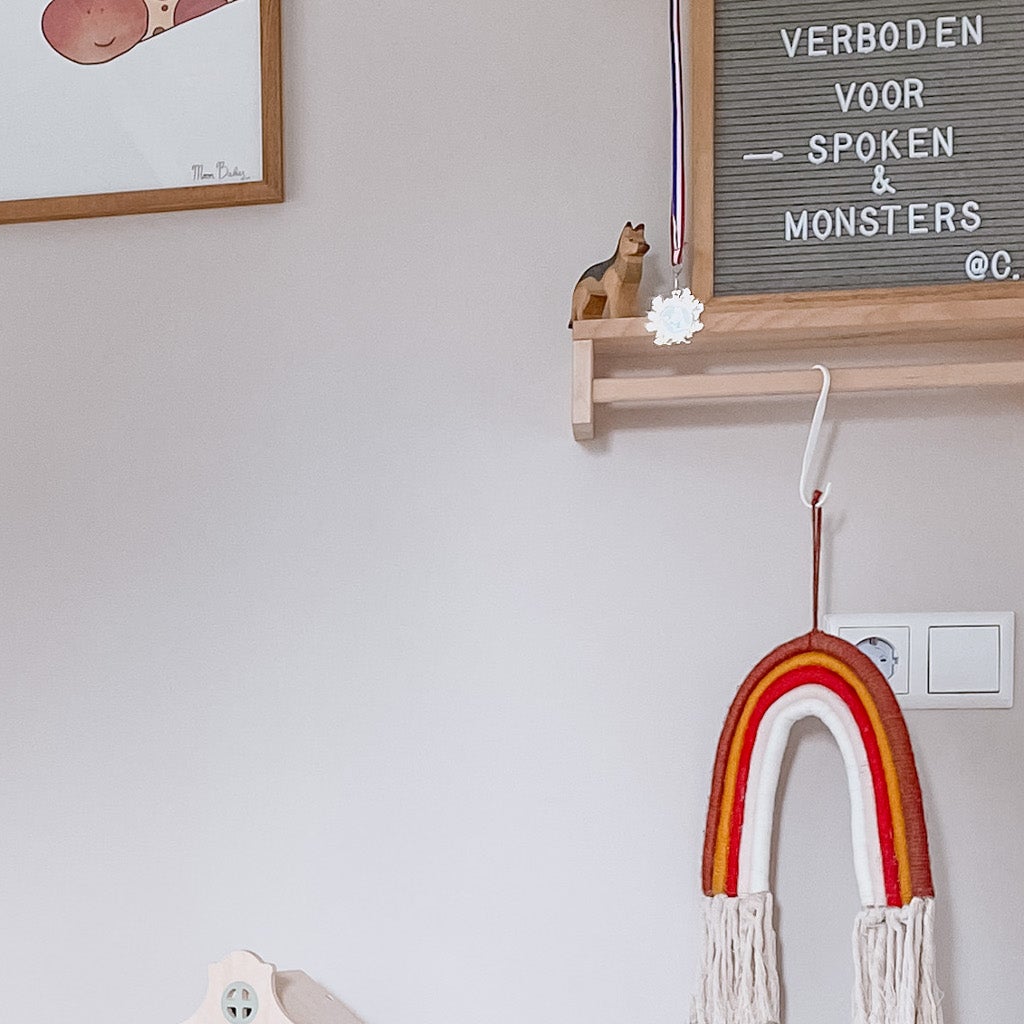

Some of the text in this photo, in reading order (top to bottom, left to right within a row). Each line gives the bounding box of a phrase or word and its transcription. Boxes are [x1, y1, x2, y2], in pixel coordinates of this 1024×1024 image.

[781, 14, 982, 58] VERBODEN
[835, 78, 924, 113] VOOR
[808, 126, 953, 165] SPOKEN
[871, 164, 896, 195] &
[785, 201, 981, 241] MONSTERS
